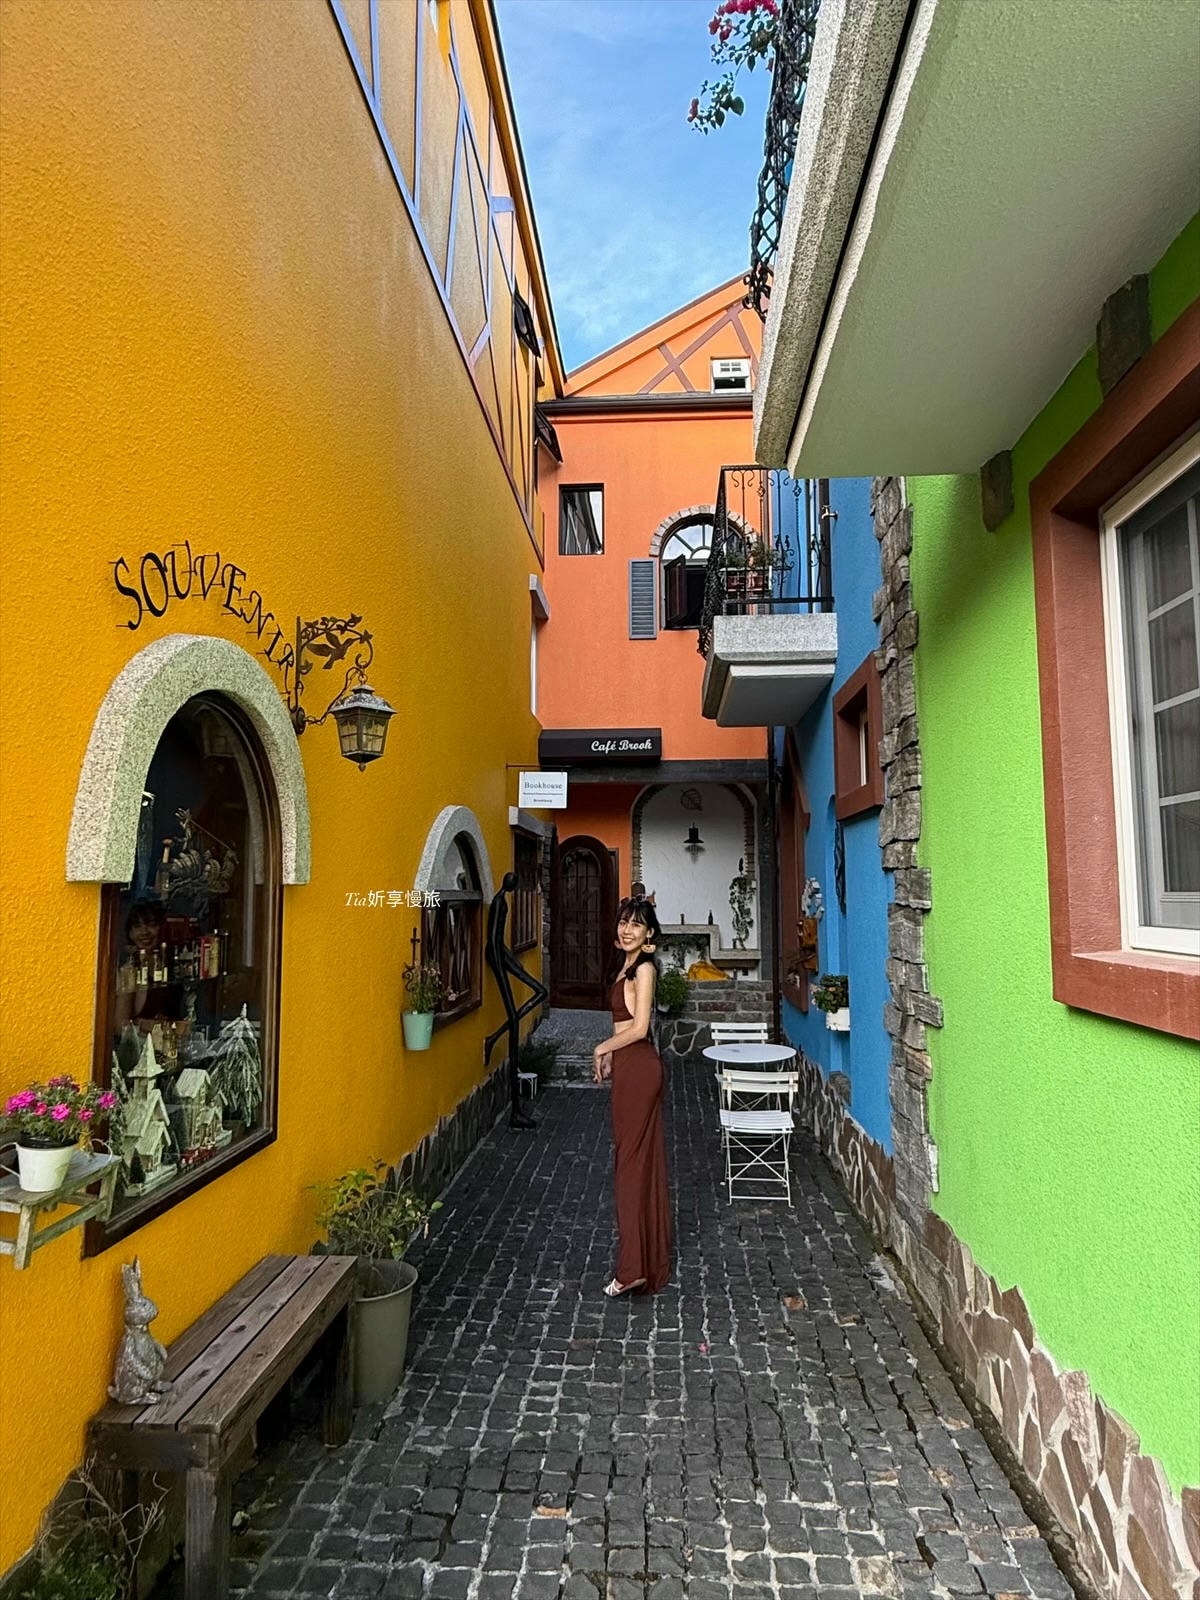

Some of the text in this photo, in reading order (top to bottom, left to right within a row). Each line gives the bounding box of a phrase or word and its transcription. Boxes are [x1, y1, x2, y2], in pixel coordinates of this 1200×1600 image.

[591, 738, 652, 754] Café Brook
[524, 781, 563, 789] Bookhouse
